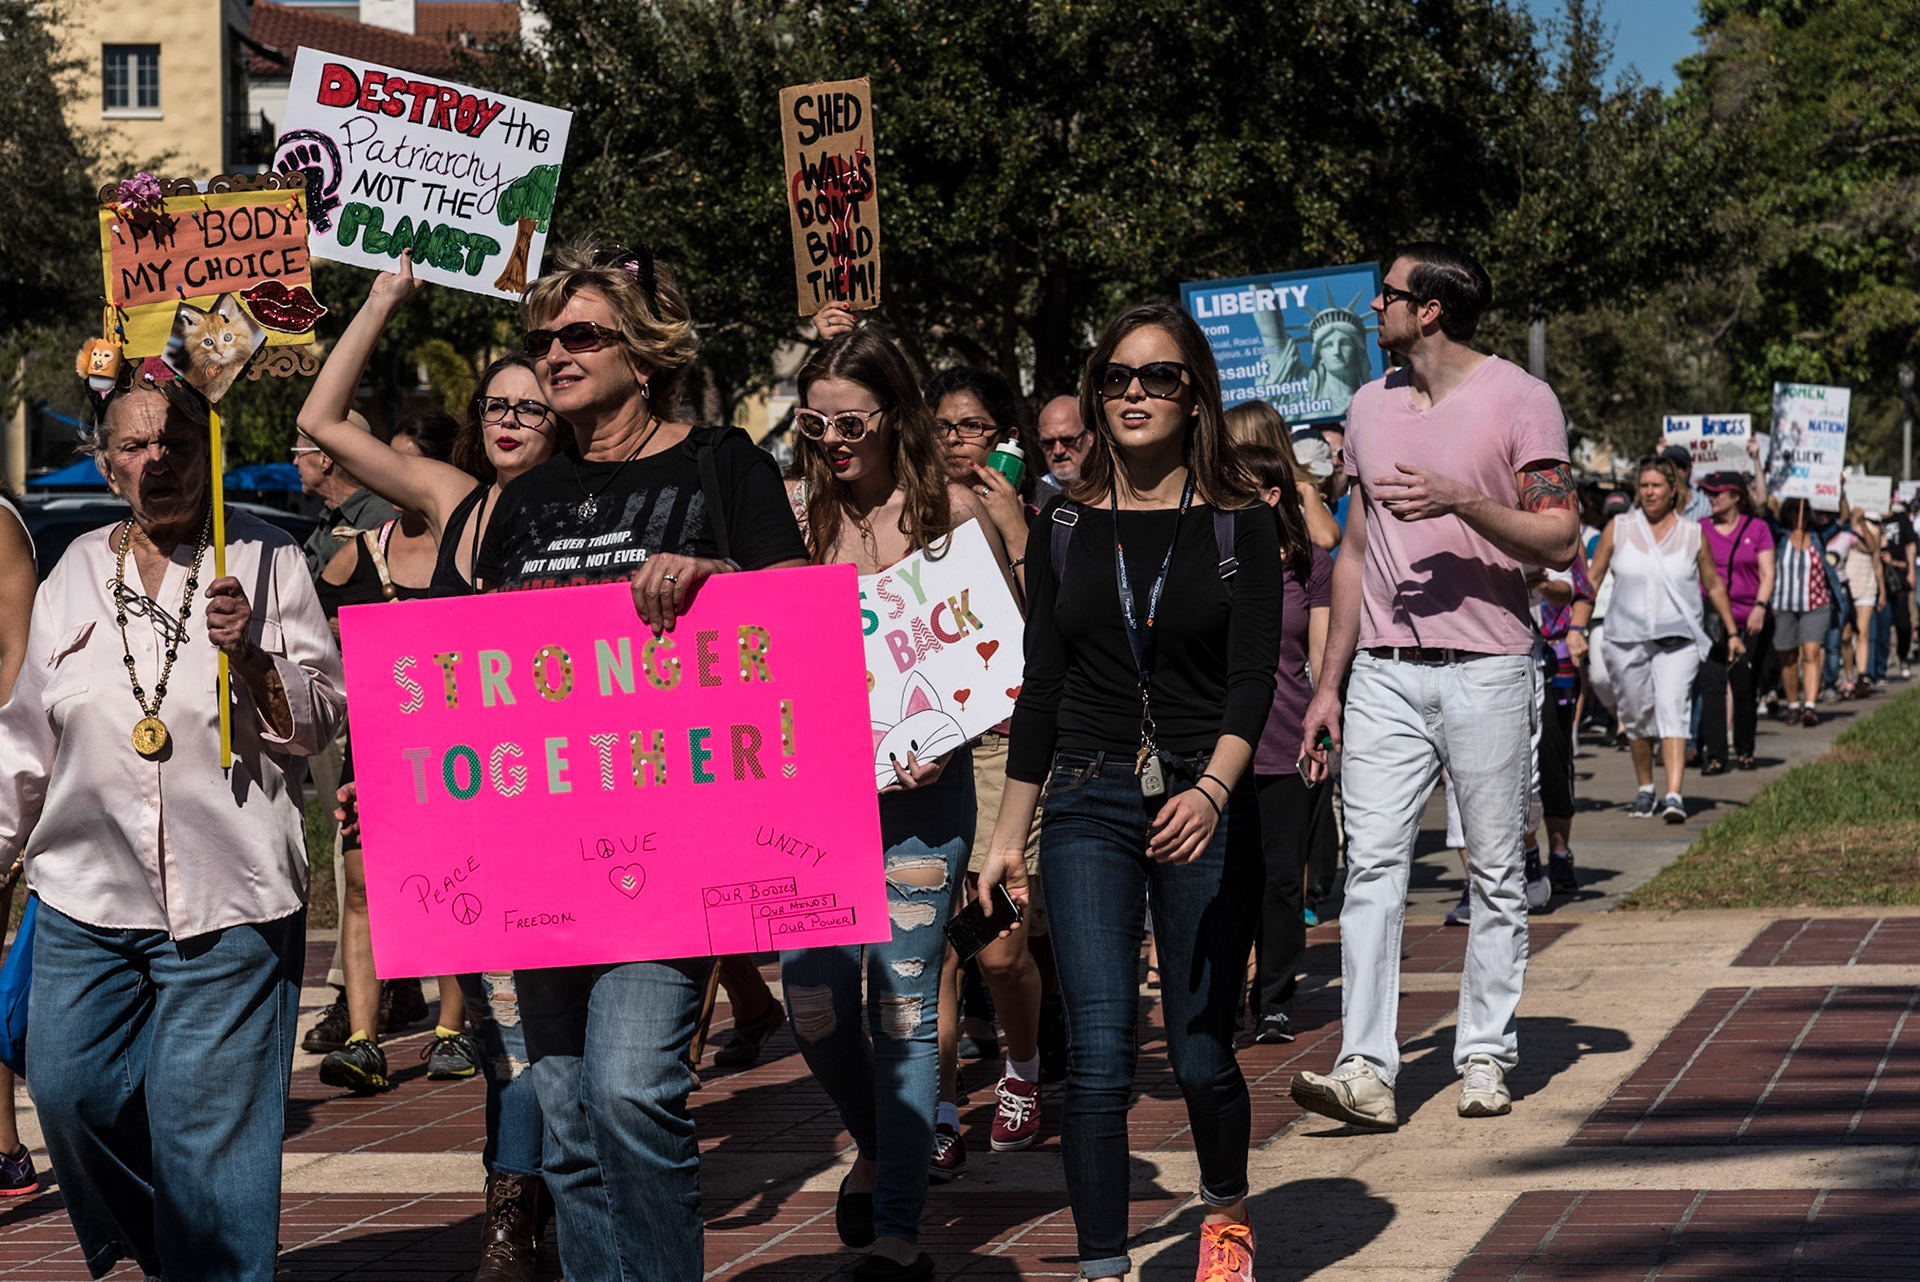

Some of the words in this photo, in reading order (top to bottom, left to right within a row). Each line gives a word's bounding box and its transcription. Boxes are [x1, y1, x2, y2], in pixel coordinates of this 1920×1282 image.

[316, 63, 506, 139] DESTROY
[499, 107, 550, 153] the
[794, 92, 862, 145] SHED
[340, 115, 519, 215] Patriarchy
[799, 150, 872, 196] WALLS
[351, 169, 416, 205] NOT
[422, 182, 478, 220] THE
[127, 215, 181, 255] MY
[203, 205, 300, 249] BODY
[337, 201, 501, 277] PLANET
[121, 258, 172, 300] MY
[184, 246, 305, 288] CHOICE
[806, 261, 876, 306] THEM!
[1195, 284, 1309, 319] LIBERTY
[1218, 360, 1269, 381] ssault
[1221, 378, 1310, 402] arassment
[1690, 440, 1715, 451] NOT
[1808, 419, 1845, 434] NATION
[521, 559, 547, 574] NOT
[550, 557, 582, 571] NOW.
[585, 552, 611, 568] NOT
[613, 548, 649, 564] EVER.
[547, 537, 586, 552] NEVER
[588, 530, 633, 548] TRUMP.
[859, 558, 928, 637] SSY
[884, 588, 984, 674] BACK
[392, 624, 775, 715] STRONGER
[402, 699, 799, 805] TOGETHER!
[579, 831, 658, 863] LOVE
[755, 825, 828, 869] UNITY
[400, 854, 481, 914] PEACE
[503, 908, 577, 933] FREEDOM
